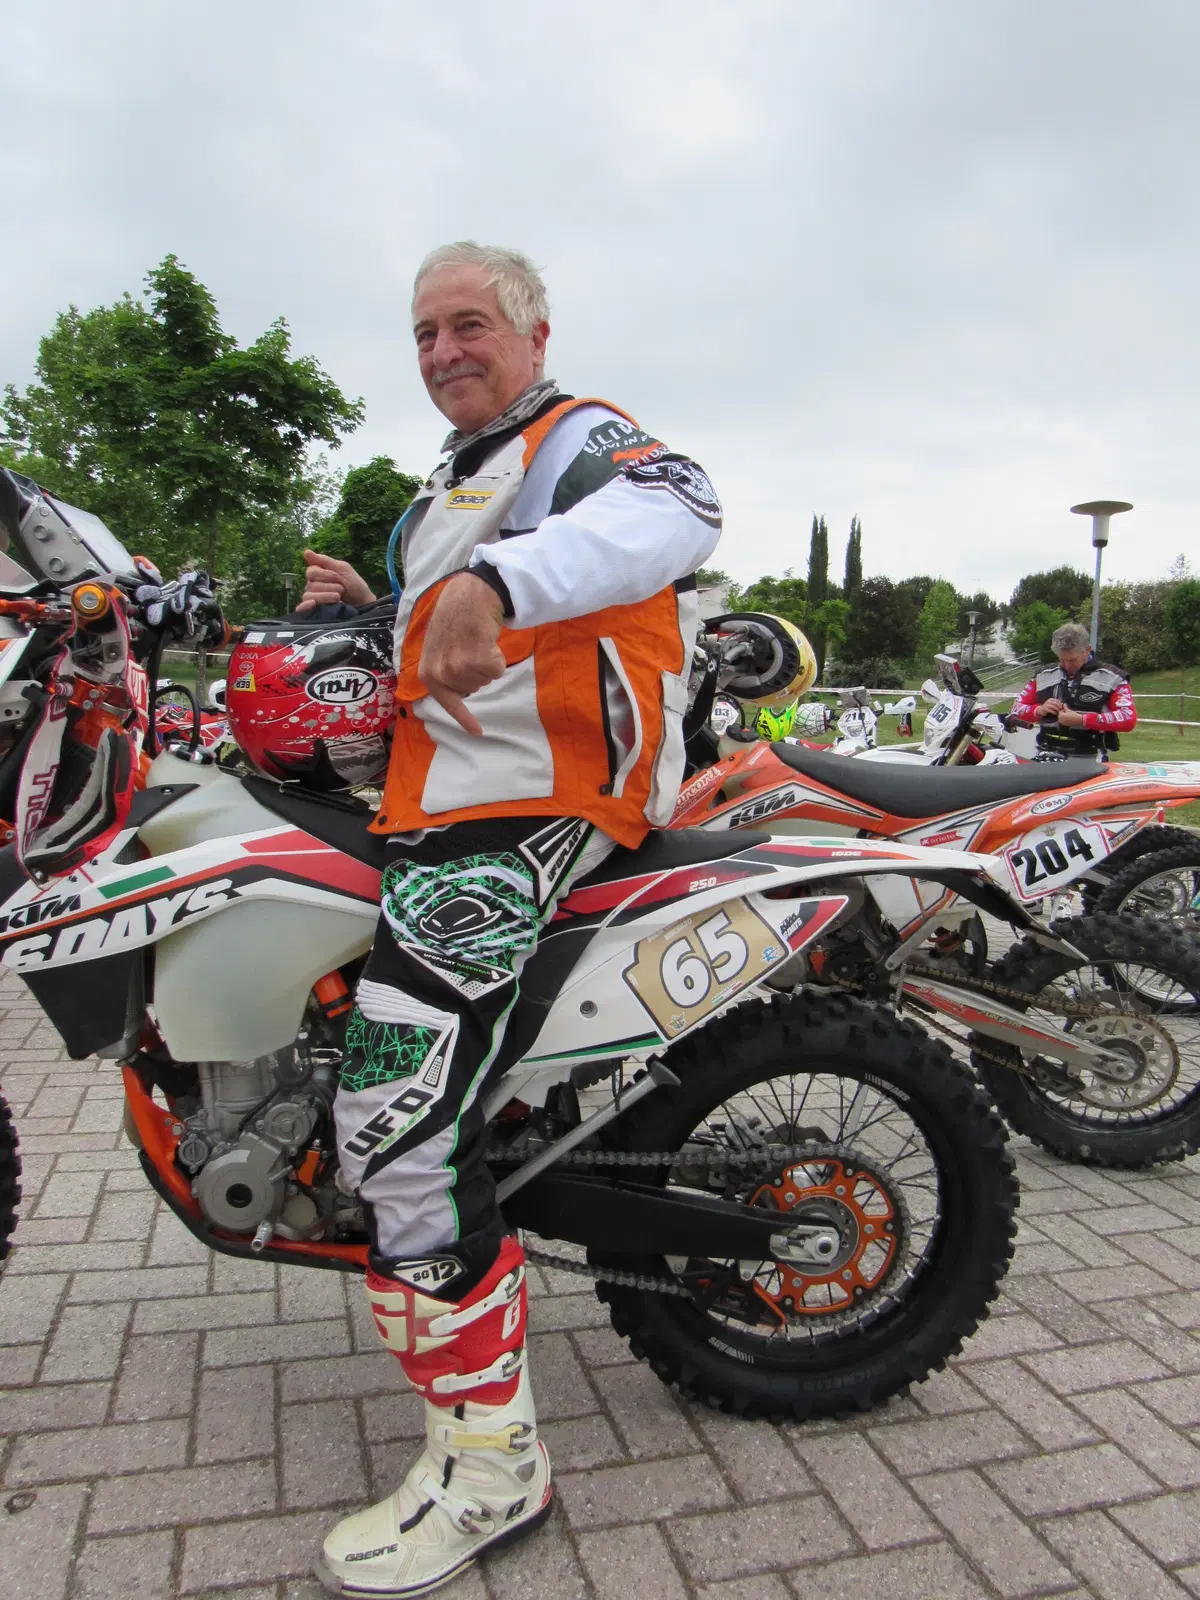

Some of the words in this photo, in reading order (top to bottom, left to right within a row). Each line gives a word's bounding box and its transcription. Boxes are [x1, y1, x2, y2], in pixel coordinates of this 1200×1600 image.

[318, 676, 373, 700] Arai
[729, 790, 796, 828] KTM
[547, 826, 583, 882] UFOPLAST
[1011, 828, 1095, 886] 204
[689, 877, 717, 892] 250
[0, 893, 82, 934] KTM
[423, 952, 455, 965] UFOPLAST
[659, 908, 749, 1008] 65
[344, 1087, 435, 1157] UFO
[344, 1543, 398, 1562] GAERNE
